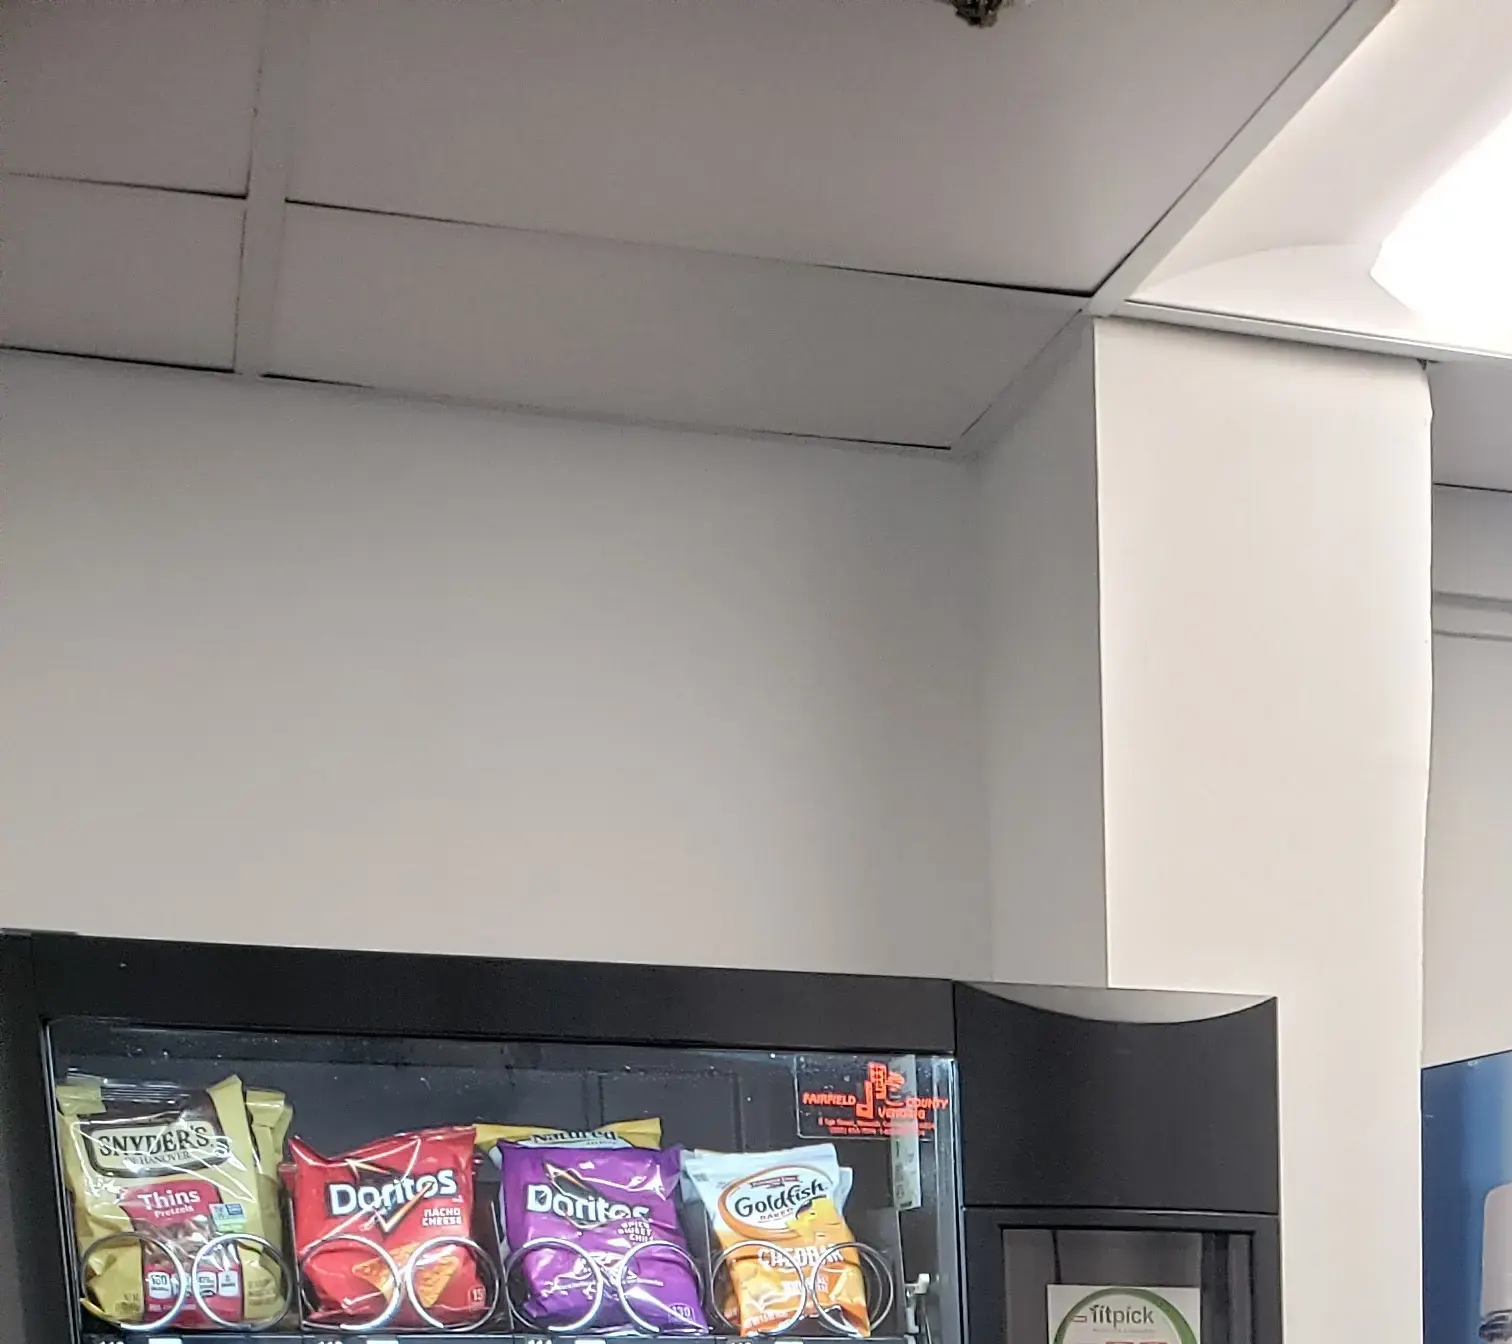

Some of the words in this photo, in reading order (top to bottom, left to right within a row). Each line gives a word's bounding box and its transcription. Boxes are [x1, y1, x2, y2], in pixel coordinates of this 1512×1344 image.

[98, 1123, 213, 1158] SNYDER'S
[138, 1186, 201, 1211] Thins
[329, 1169, 457, 1216] Doritos
[526, 1183, 651, 1226] Doritos
[734, 1178, 828, 1218] Goldfish
[154, 1203, 195, 1218] Pretzels
[422, 1216, 463, 1226] CHEESE
[423, 1207, 462, 1219] NACHO
